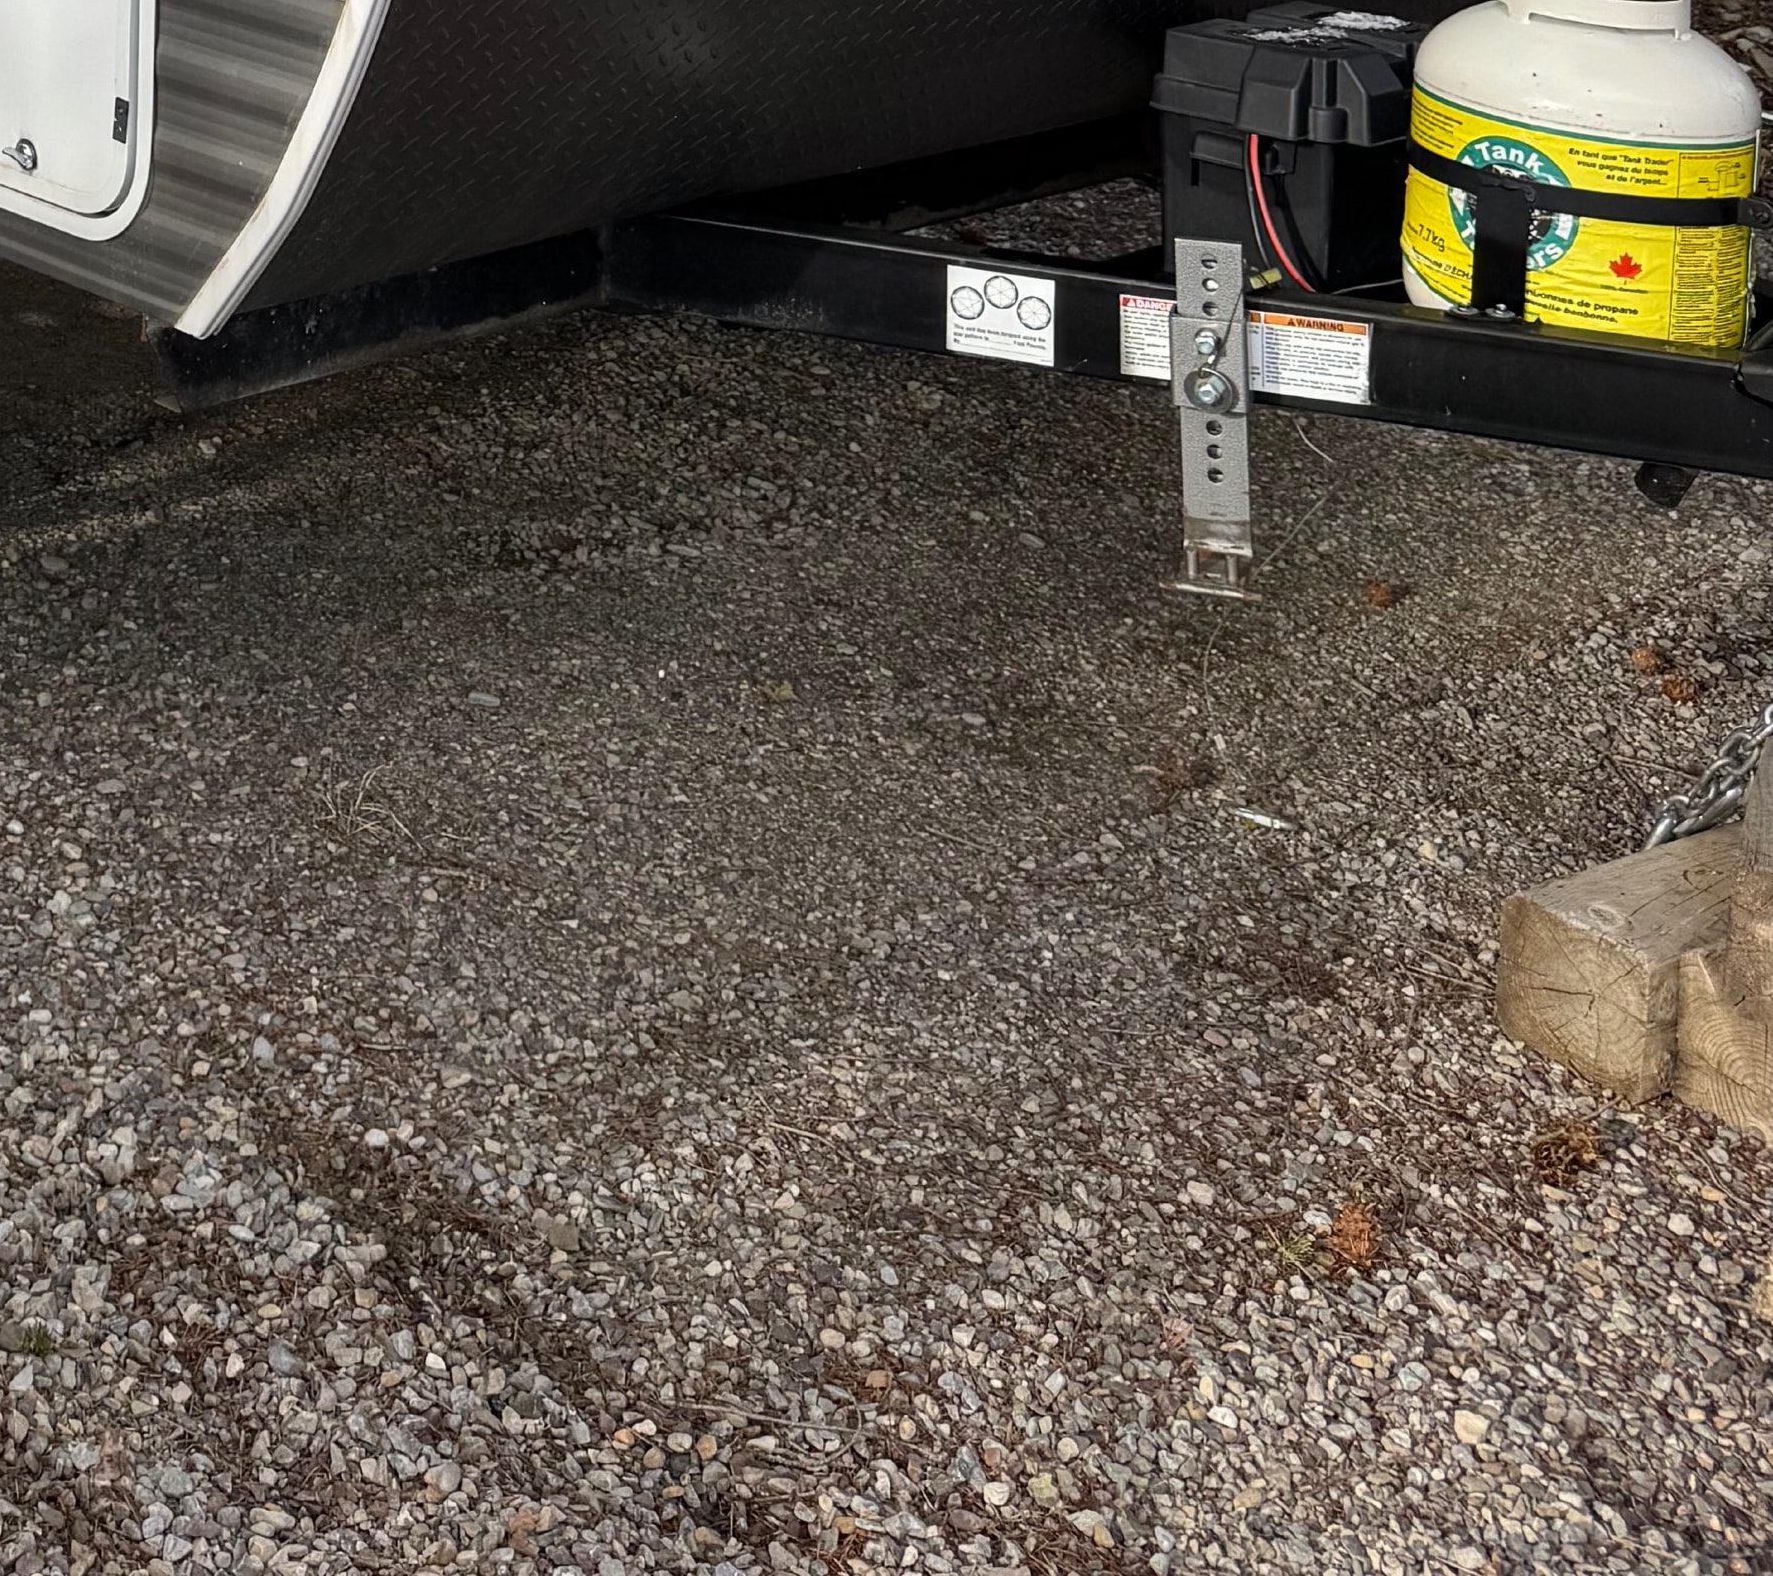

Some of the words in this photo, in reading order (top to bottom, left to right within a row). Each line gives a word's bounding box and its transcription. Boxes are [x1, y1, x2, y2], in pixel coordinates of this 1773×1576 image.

[1474, 141, 1544, 175] Tank
[1568, 147, 1581, 156] En
[1577, 299, 1592, 309] de
[1593, 302, 1639, 316] propane
[1295, 318, 1345, 333] WARNING
